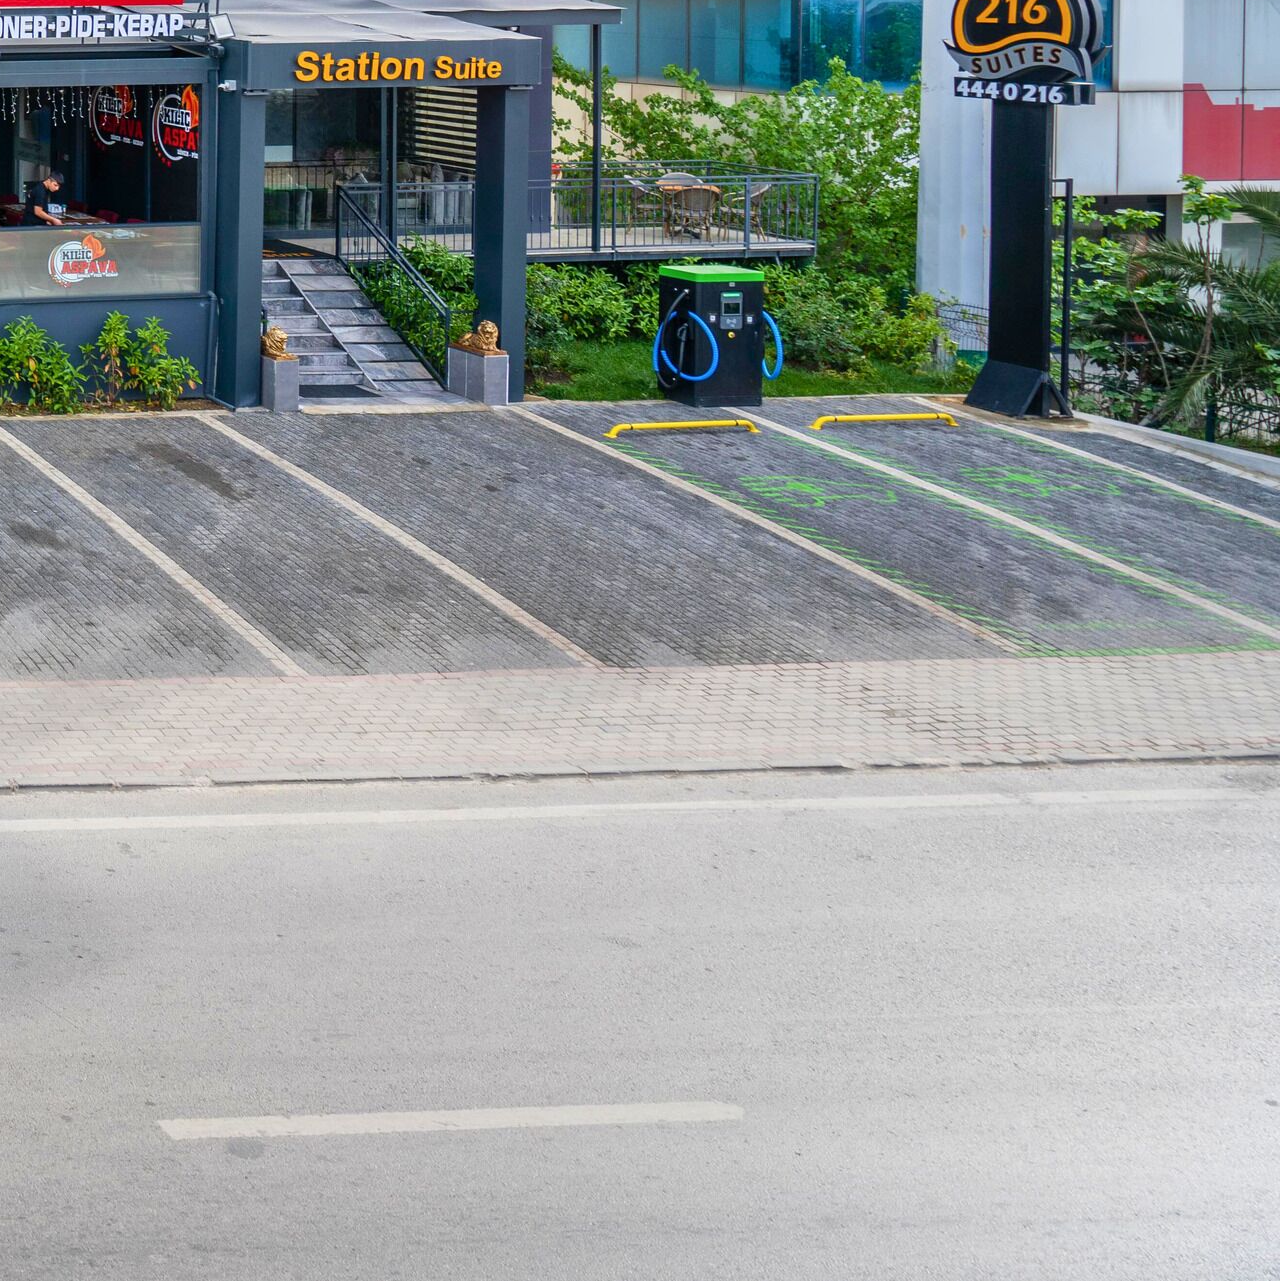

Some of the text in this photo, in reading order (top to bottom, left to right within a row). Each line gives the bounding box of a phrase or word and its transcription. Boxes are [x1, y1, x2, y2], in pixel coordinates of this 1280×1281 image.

[294, 51, 503, 83] Station Suite
[971, 46, 1062, 74] SUITES
[61, 260, 118, 274] ASPAVA
